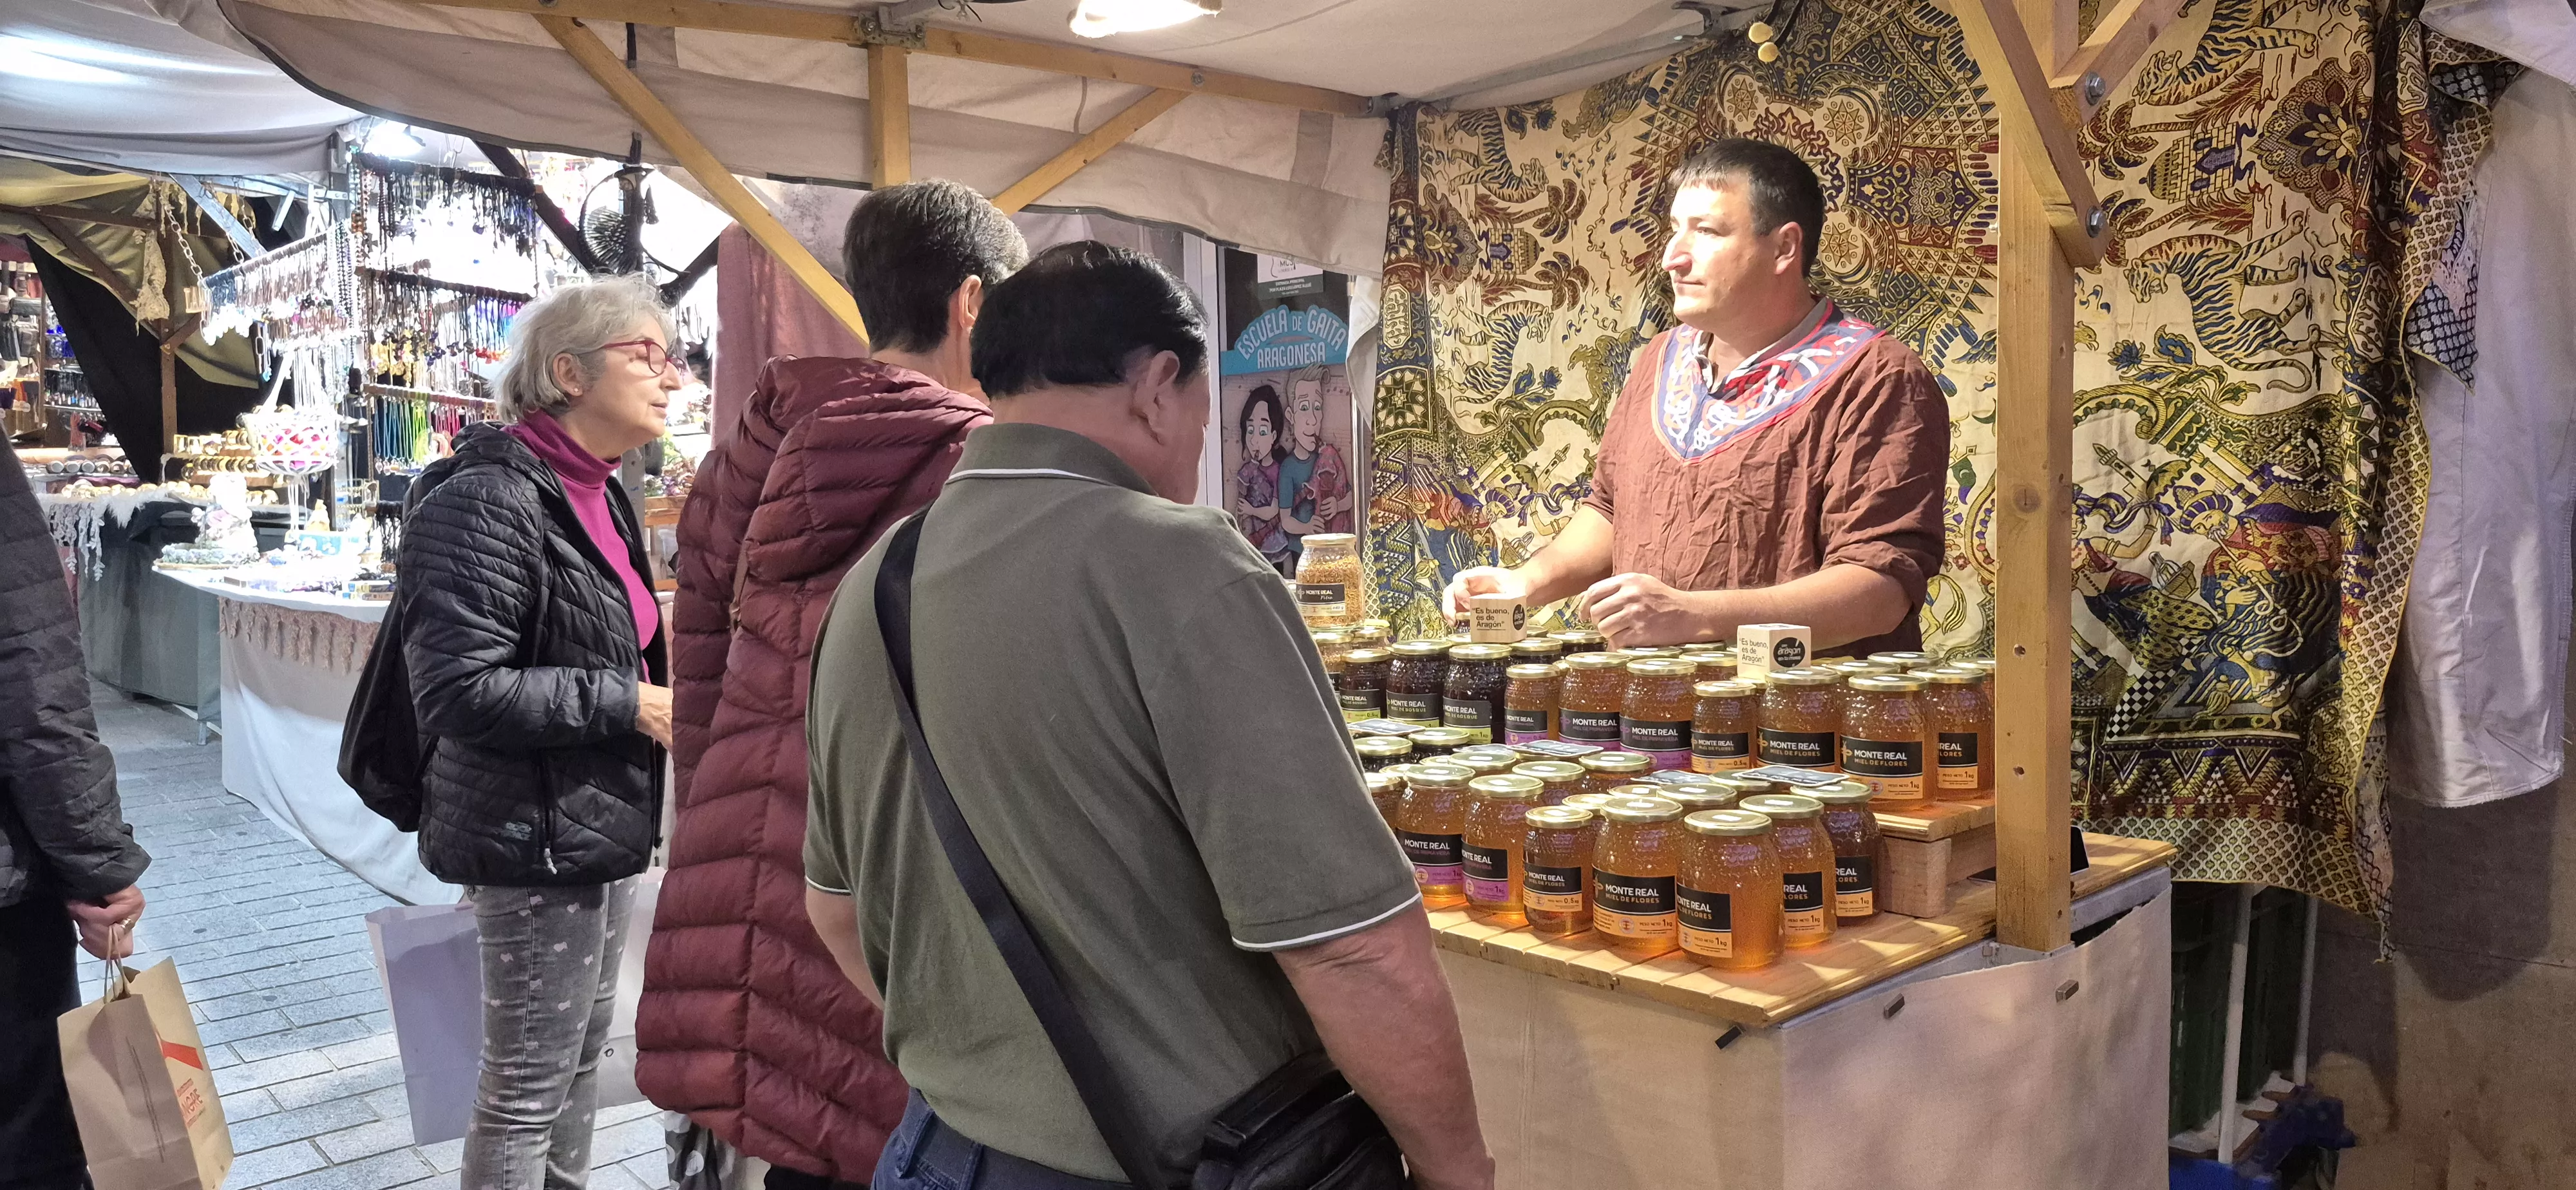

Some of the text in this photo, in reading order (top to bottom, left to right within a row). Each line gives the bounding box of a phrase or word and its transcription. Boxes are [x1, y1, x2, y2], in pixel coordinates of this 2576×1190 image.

[1237, 309, 1347, 360] ESCUELA DE GAITA
[1257, 341, 1325, 369] ARAGONESA
[1749, 639, 1768, 649] bueno,
[1390, 699, 1408, 707] MONTE
[1572, 718, 1597, 726] MONTE
[1632, 726, 1657, 736] MONTE
[1770, 740, 1797, 750] MONTE
[1854, 749, 1908, 760] MONTE REAL
[1404, 838, 1450, 850] MONTE REAL
[1473, 853, 1492, 864] REAL
[1528, 871, 1547, 880] MONTE
[1605, 883, 1660, 896] MONTE REAL
[1783, 884, 1808, 892] REAL
[1690, 901, 1712, 912] REAL
[1687, 909, 1712, 920] FLORES
